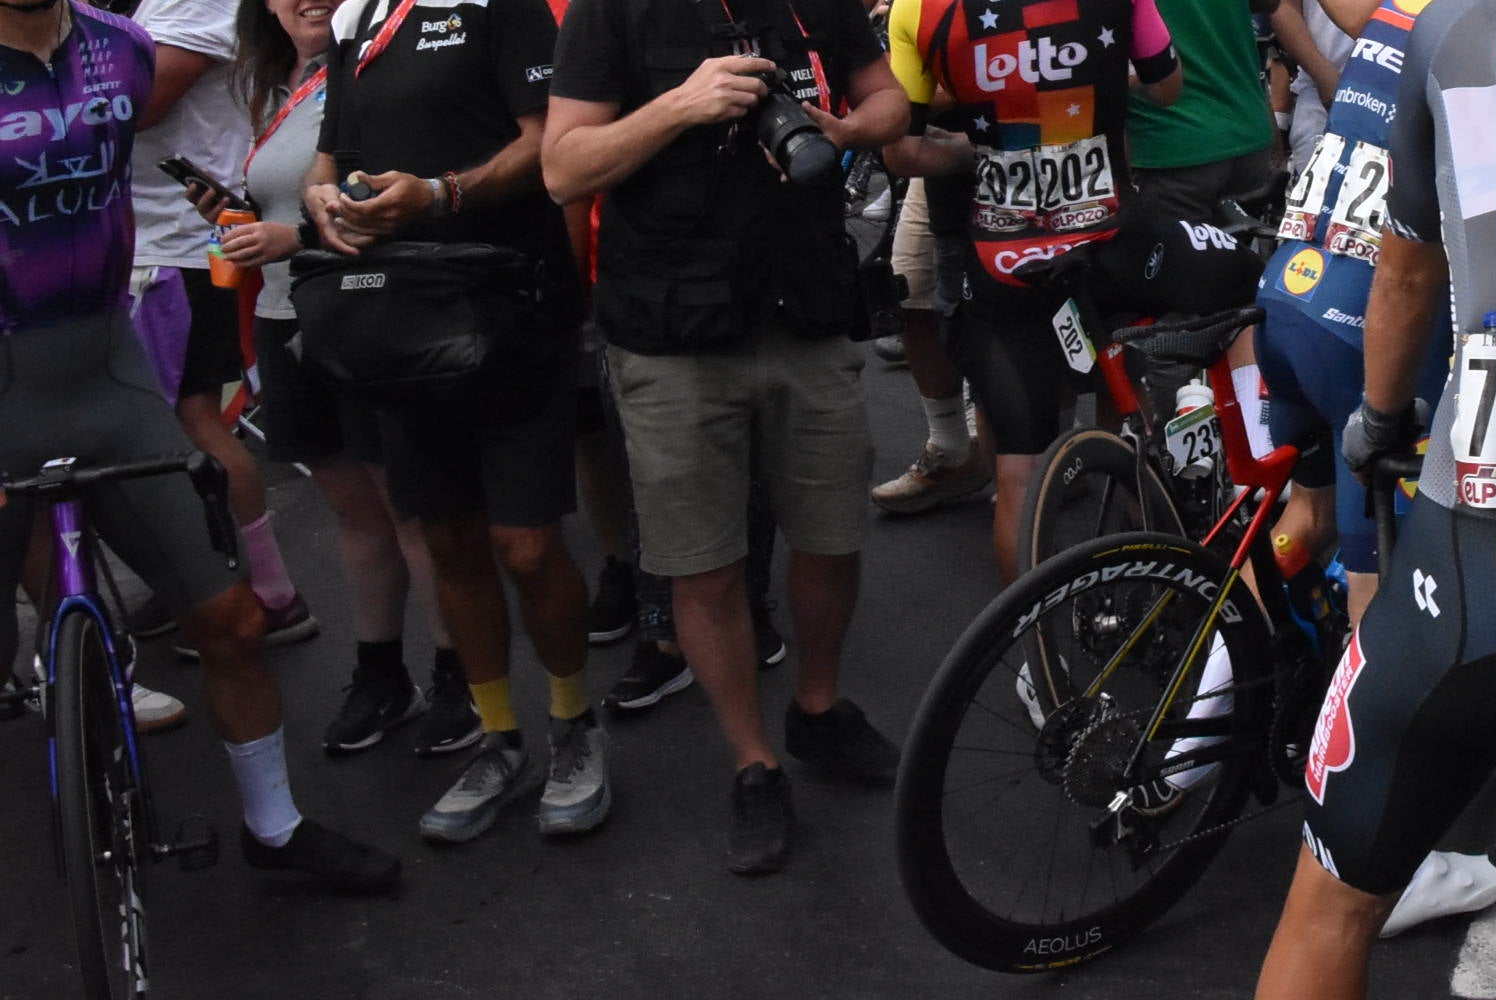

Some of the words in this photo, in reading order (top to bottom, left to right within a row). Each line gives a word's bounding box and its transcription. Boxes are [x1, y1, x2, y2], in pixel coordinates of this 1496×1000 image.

[416, 32, 466, 51] Burpellet
[974, 37, 1088, 92] lotto
[83, 80, 122, 94] GIANT
[0, 95, 134, 141] ayco
[1040, 147, 1110, 209] 202
[1288, 262, 1318, 282] LIDL
[1059, 316, 1083, 362] 202
[1314, 744, 1327, 783] HAIR
[1325, 666, 1354, 742] BOOSTER
[1024, 927, 1102, 954] AEOLUS
